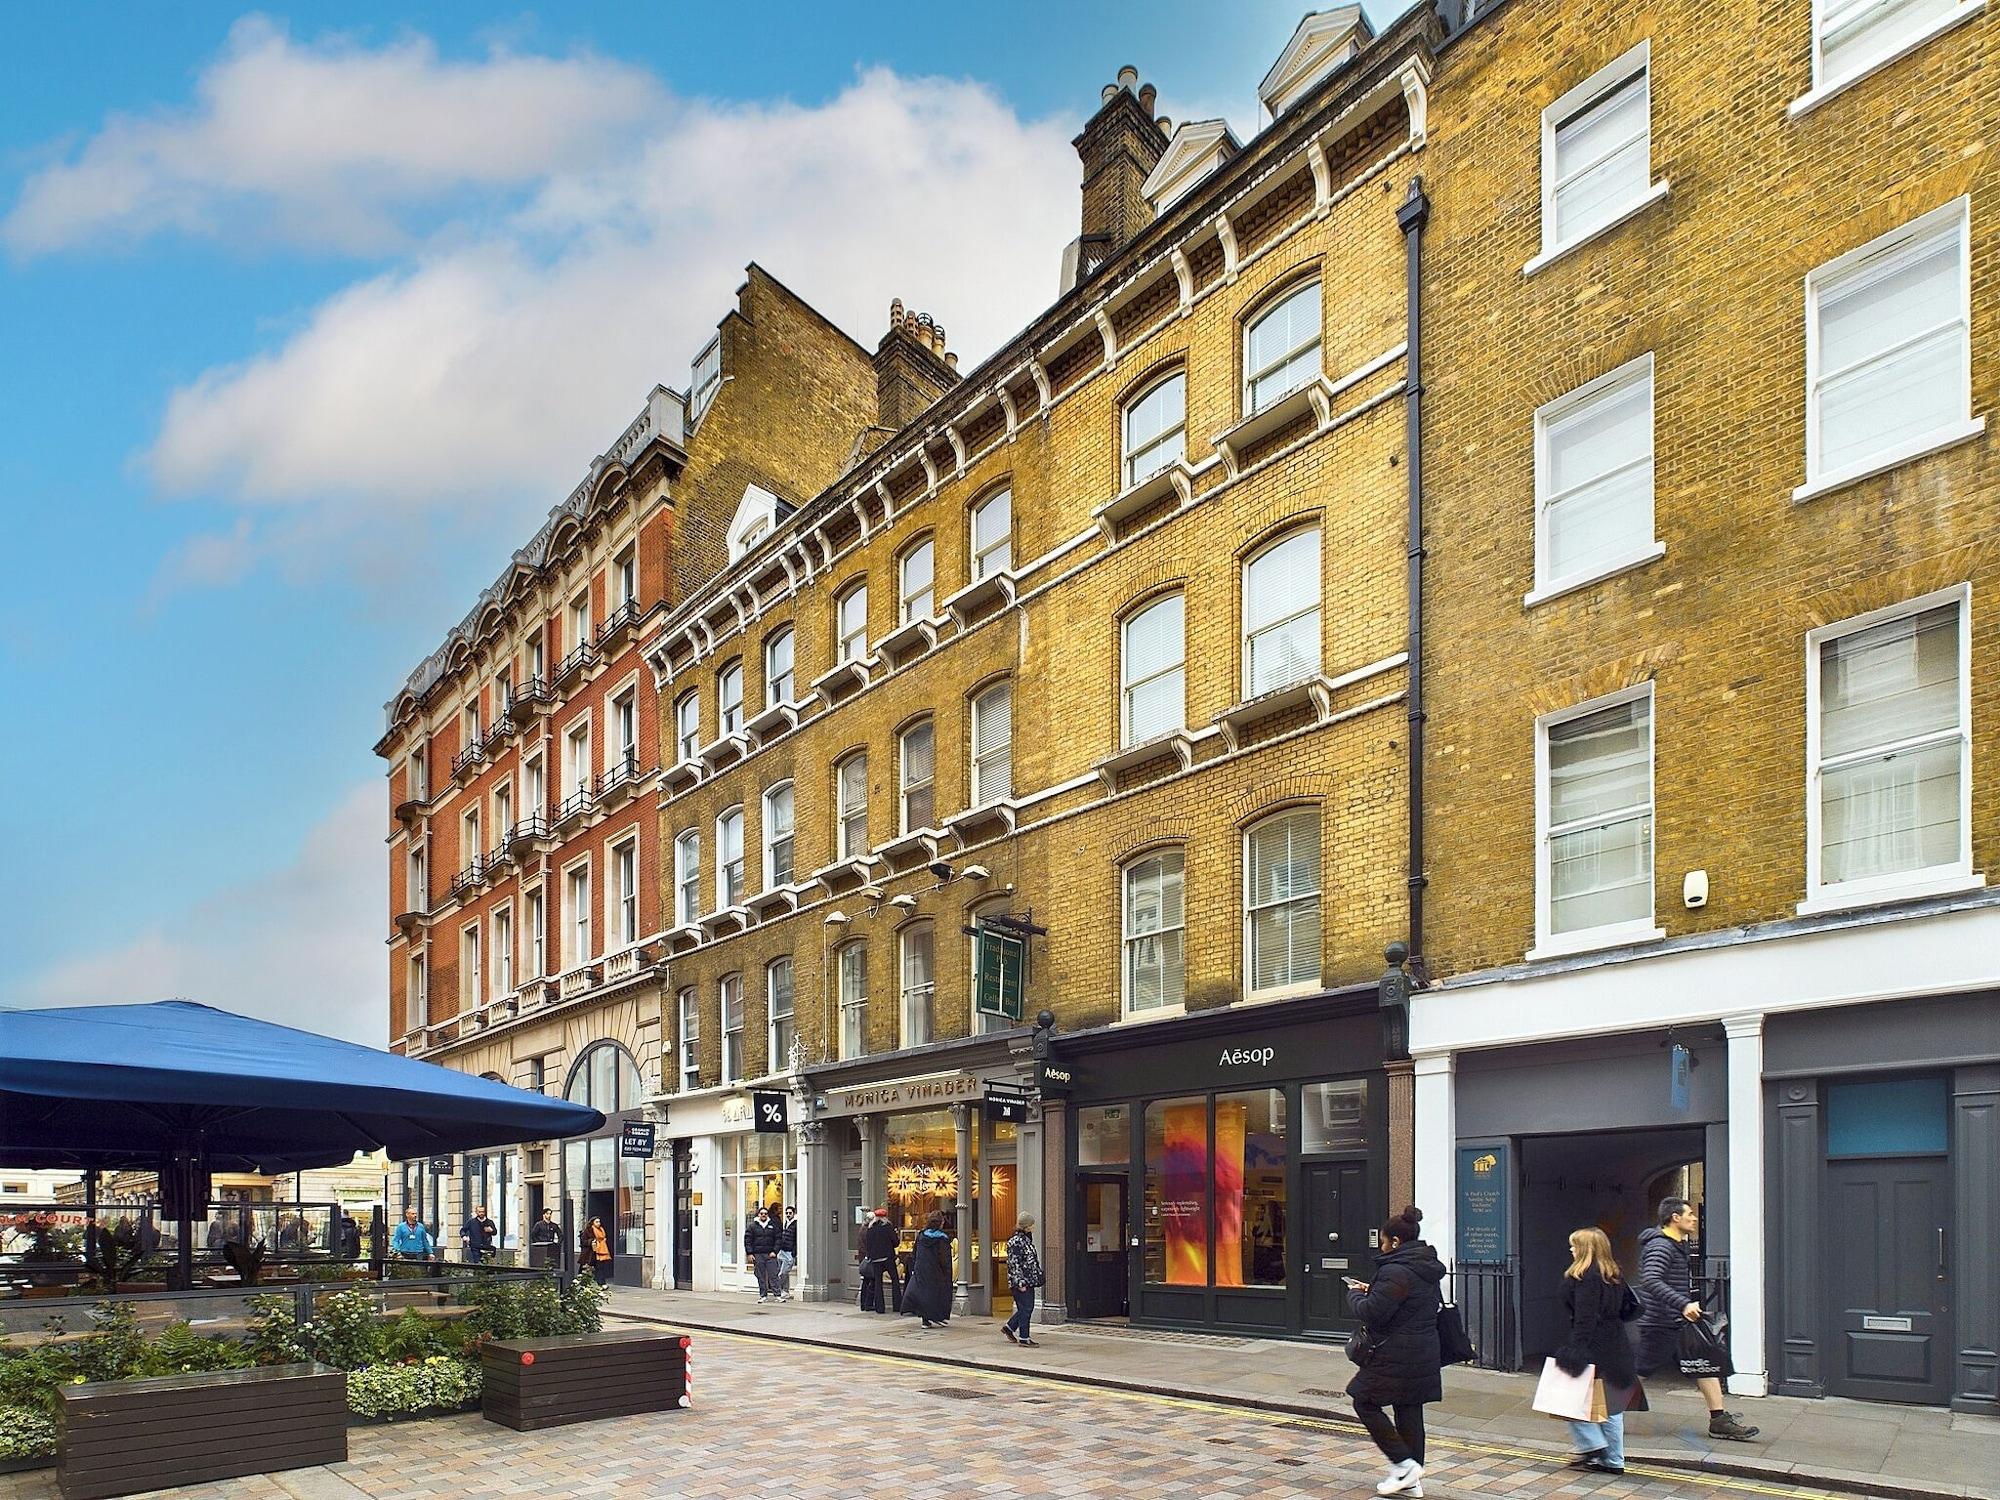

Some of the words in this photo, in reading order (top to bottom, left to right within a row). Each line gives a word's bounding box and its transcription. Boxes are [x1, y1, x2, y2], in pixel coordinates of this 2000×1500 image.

[1219, 1047, 1275, 1066] Aēsop
[845, 1089, 899, 1108] MONICA
[905, 1077, 977, 1100] VINADER
[35, 1212, 94, 1226] COURT
